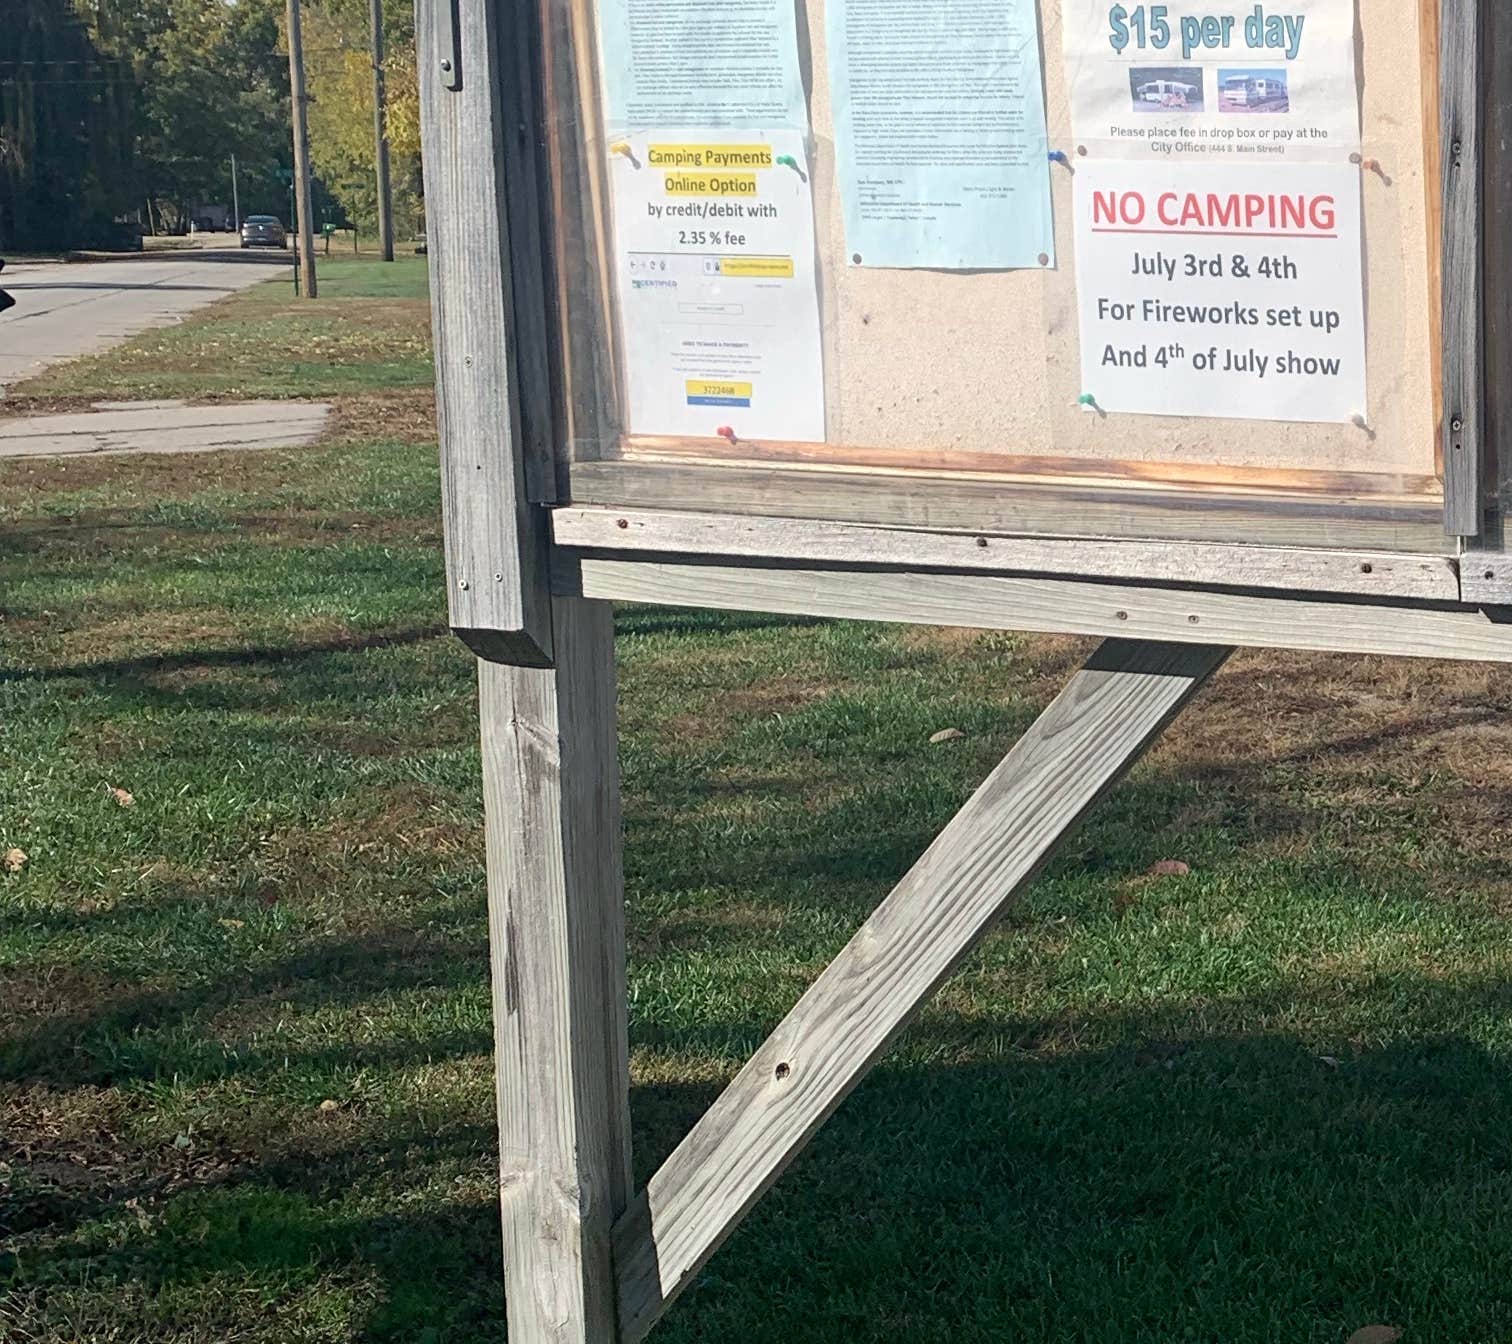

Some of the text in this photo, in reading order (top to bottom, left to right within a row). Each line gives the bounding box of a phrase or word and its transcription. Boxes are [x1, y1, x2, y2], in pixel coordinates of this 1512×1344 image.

[1108, 3, 1305, 59] $15 per day
[1111, 127, 1328, 141] Please place fee in drop box or pay at the
[1151, 142, 1172, 154] City
[1175, 142, 1206, 153] Office
[1237, 144, 1254, 152] Main
[648, 149, 772, 167] Camping Payments
[665, 177, 756, 195] Online Option
[648, 203, 777, 218] by credit/debit with
[1093, 191, 1335, 229] NO CAMPING
[679, 231, 746, 246] 2.35 % fee
[1132, 252, 1297, 281] July 3rd & 4th
[1098, 298, 1340, 333] For Fireworks set up
[1102, 344, 1147, 367] And
[1192, 347, 1216, 370] of
[1223, 348, 1268, 378] July
[1276, 352, 1341, 375] show
